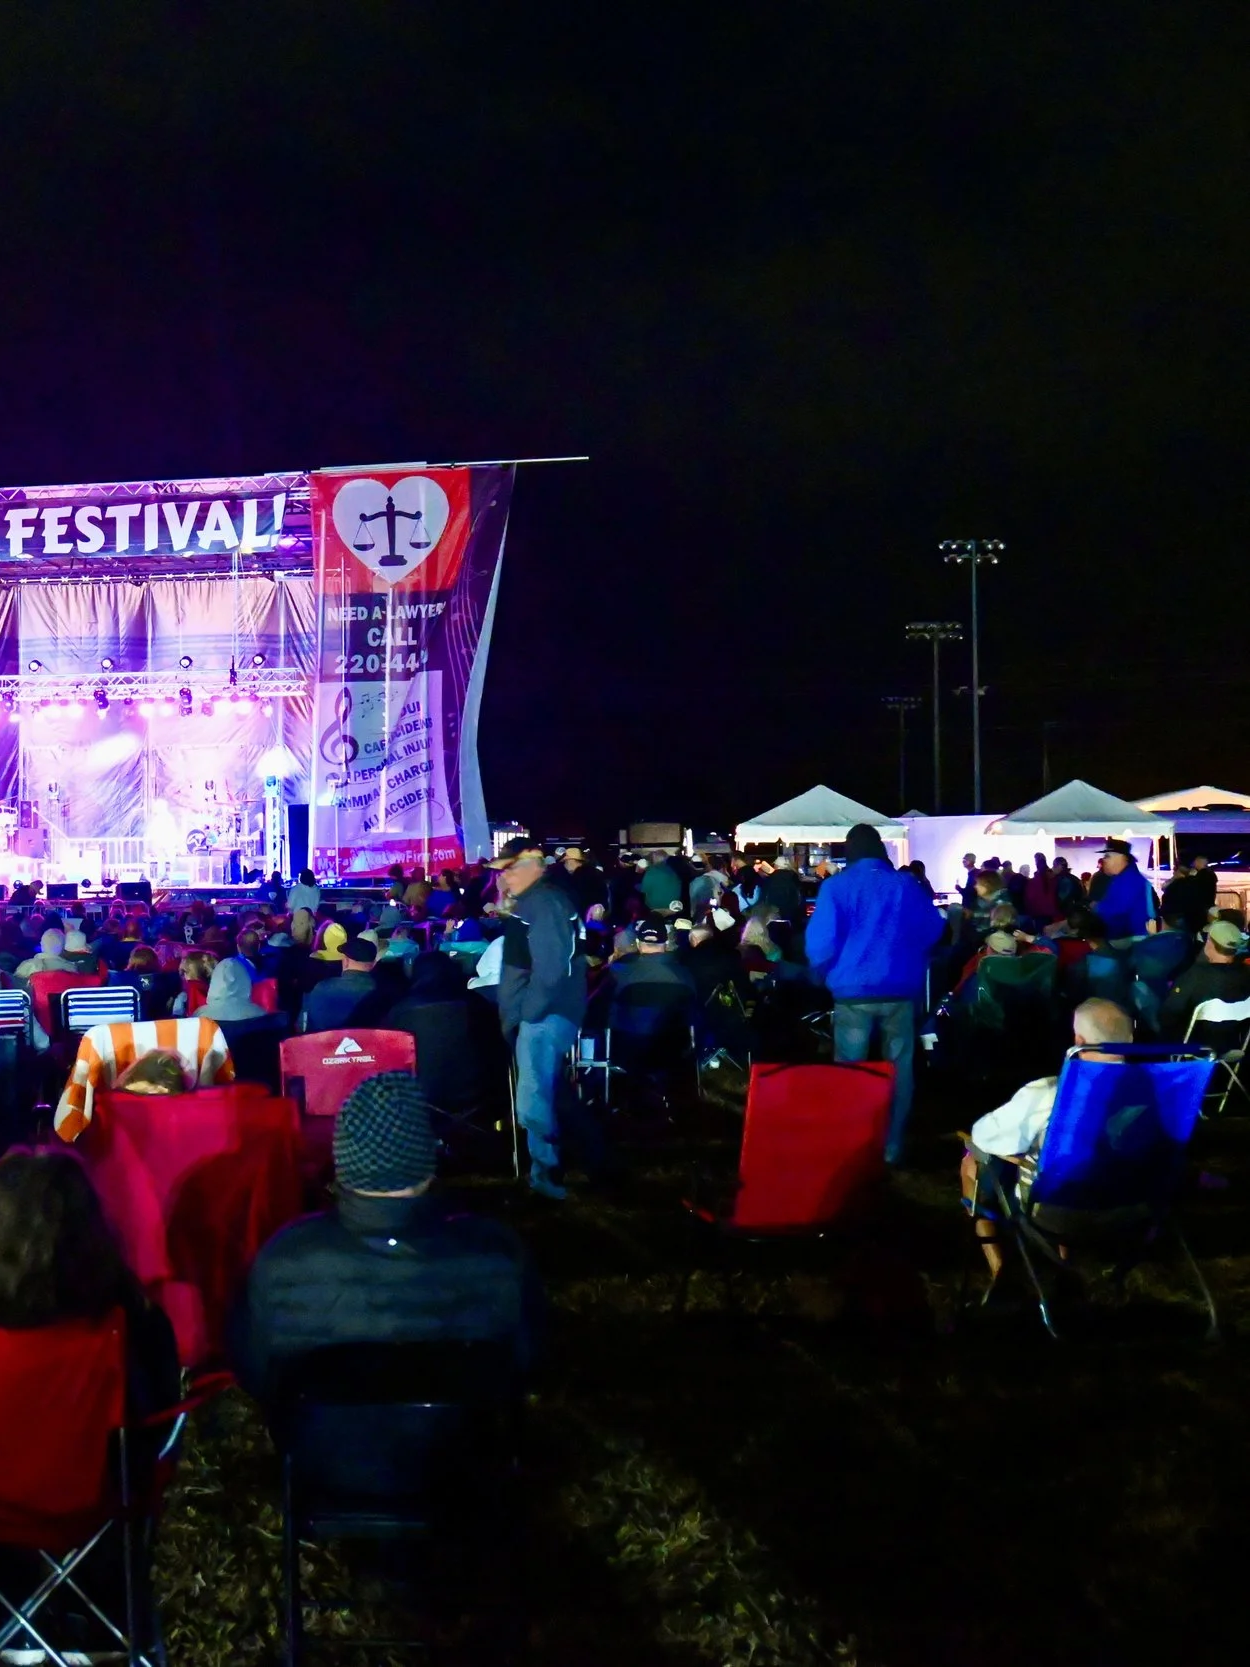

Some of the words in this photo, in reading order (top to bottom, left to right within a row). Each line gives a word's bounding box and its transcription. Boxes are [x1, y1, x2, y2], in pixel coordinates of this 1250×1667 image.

[4, 493, 287, 557] FESTIVAL!
[327, 606, 369, 620] NEED
[372, 606, 382, 620] A
[367, 627, 417, 647] CALL
